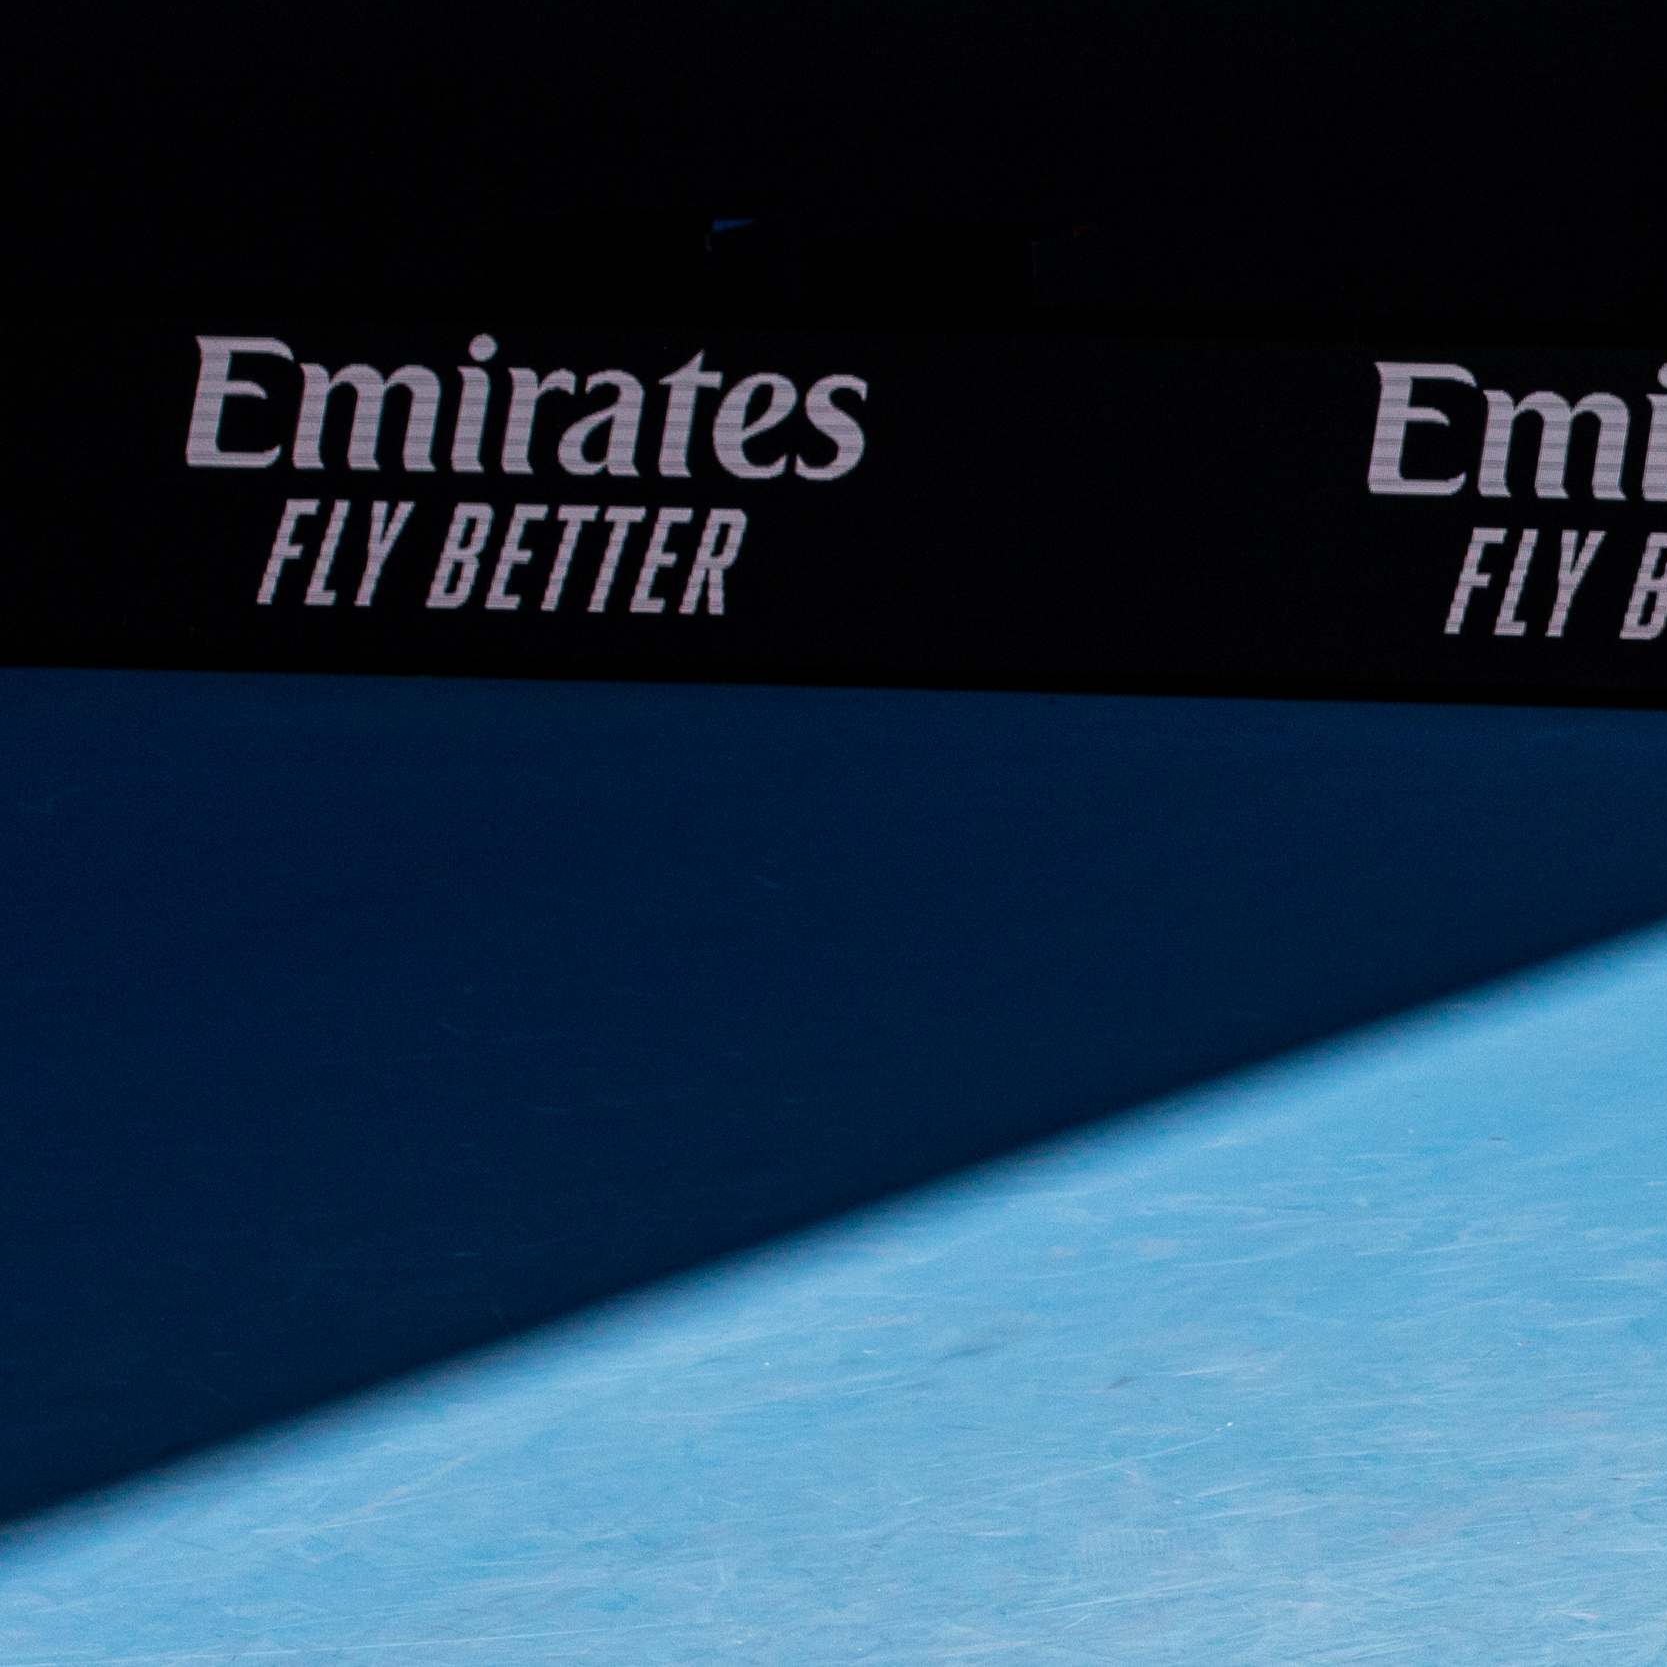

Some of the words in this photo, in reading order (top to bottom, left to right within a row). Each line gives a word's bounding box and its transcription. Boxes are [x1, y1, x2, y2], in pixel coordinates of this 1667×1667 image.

[186, 334, 868, 480] Emirates
[257, 499, 414, 606] FLY
[426, 503, 747, 615] BETTER
[1445, 528, 1605, 637] FLY
